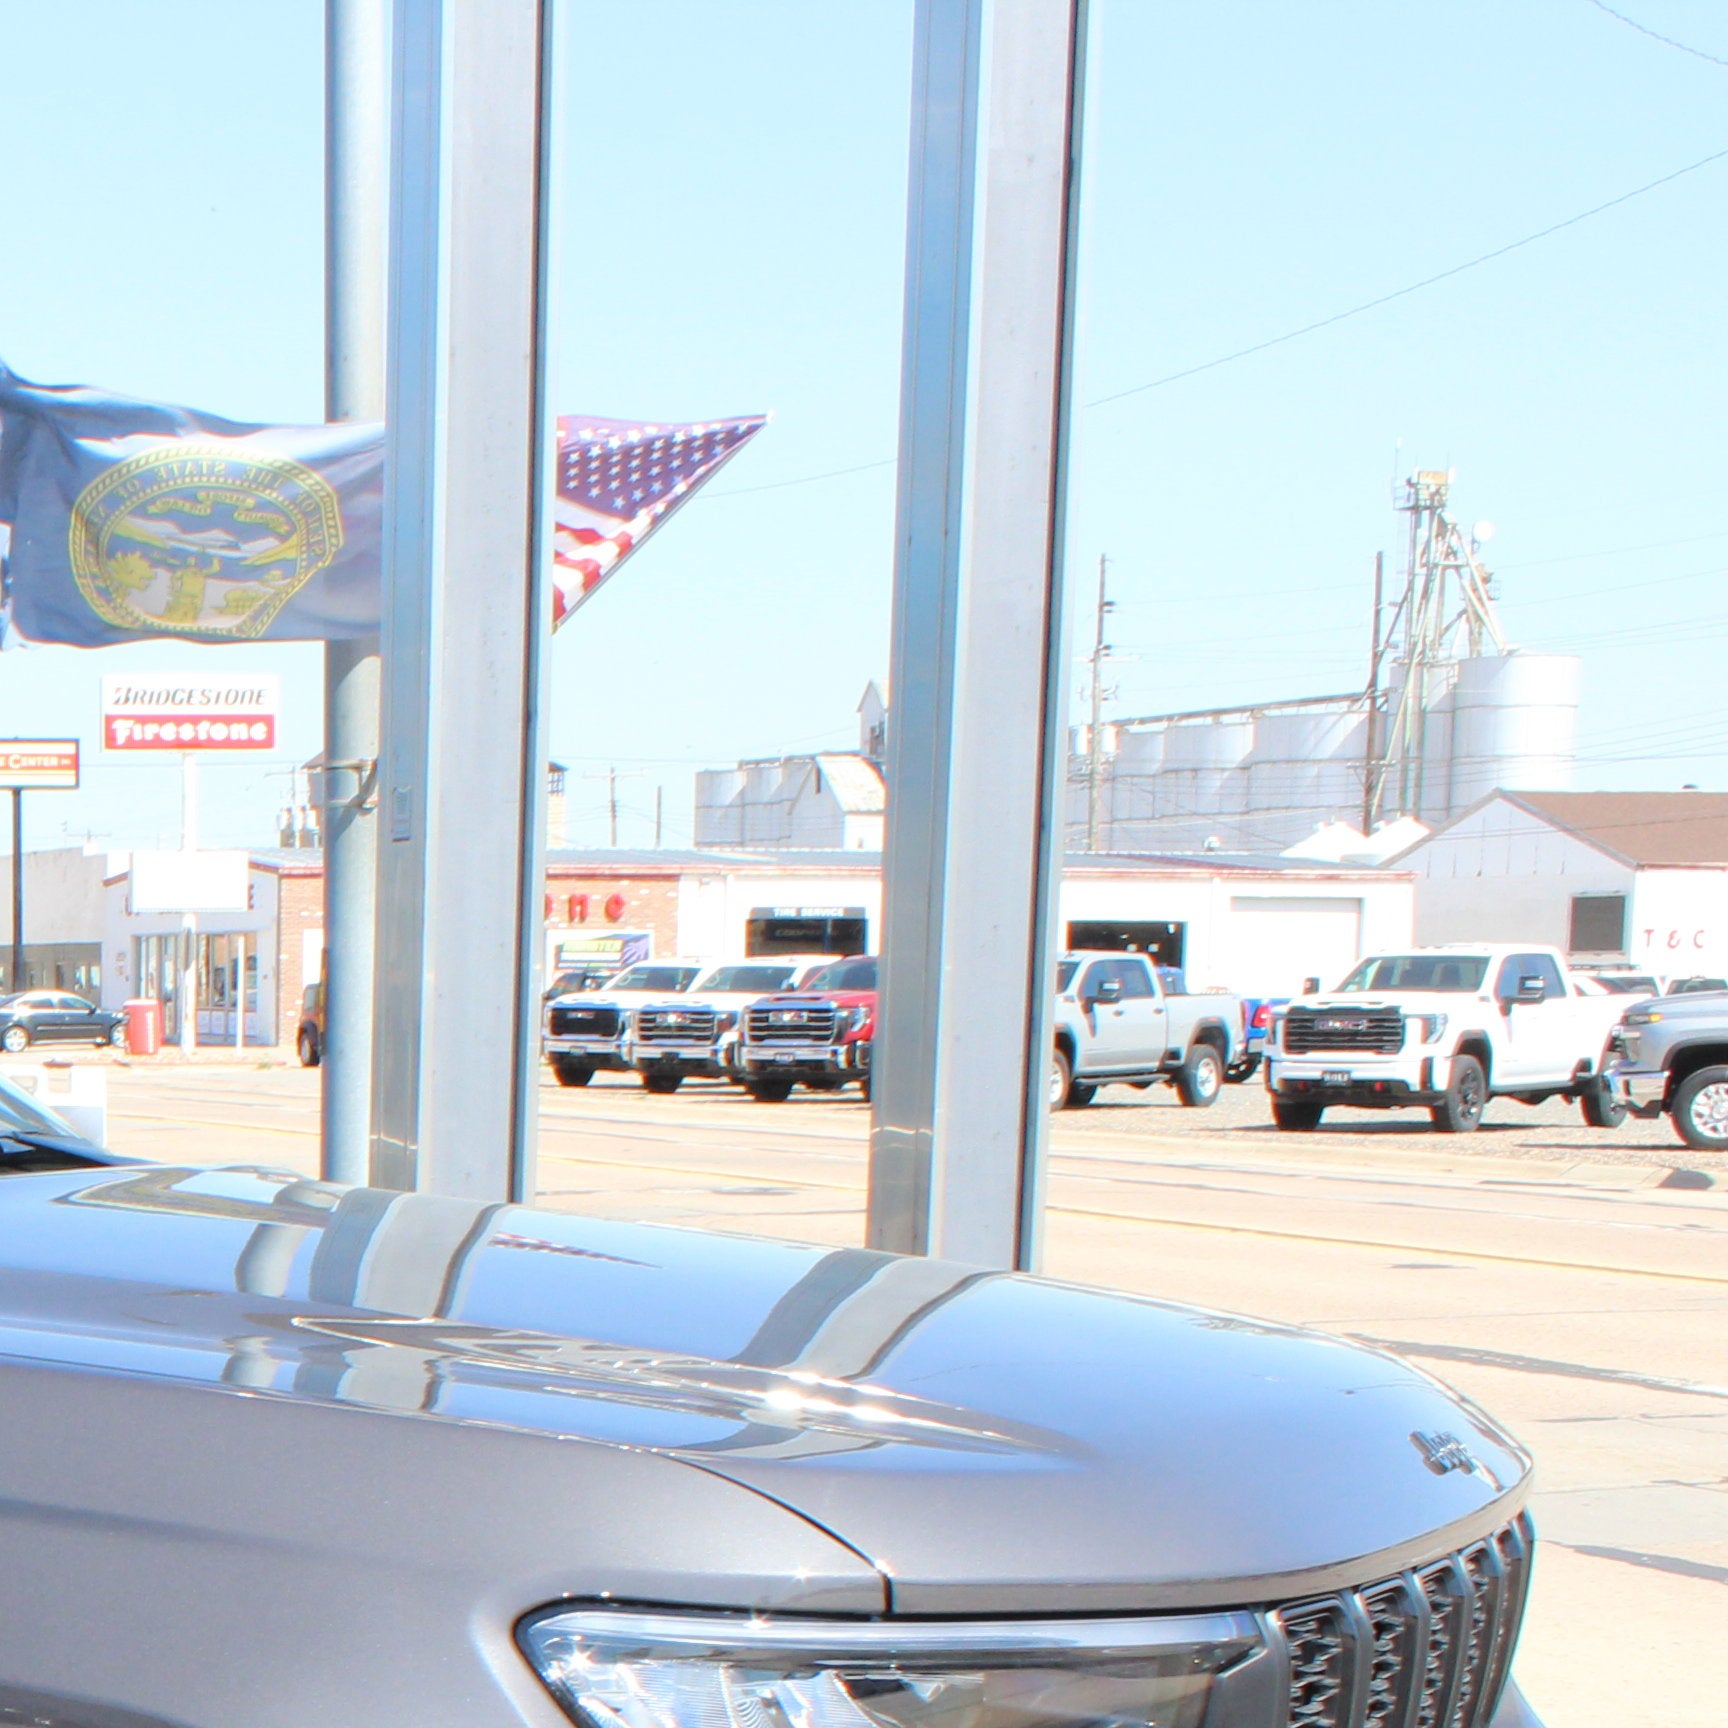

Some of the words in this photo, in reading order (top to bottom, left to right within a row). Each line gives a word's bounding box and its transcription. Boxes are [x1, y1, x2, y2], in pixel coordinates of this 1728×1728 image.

[112, 686, 268, 706] BRIDGESTONE
[111, 718, 268, 747] Firestone
[8, 754, 59, 769] CENTER
[800, 907, 844, 917] SERVICE
[1643, 928, 1656, 948] T
[1666, 929, 1681, 950] &
[1692, 929, 1706, 949] C
